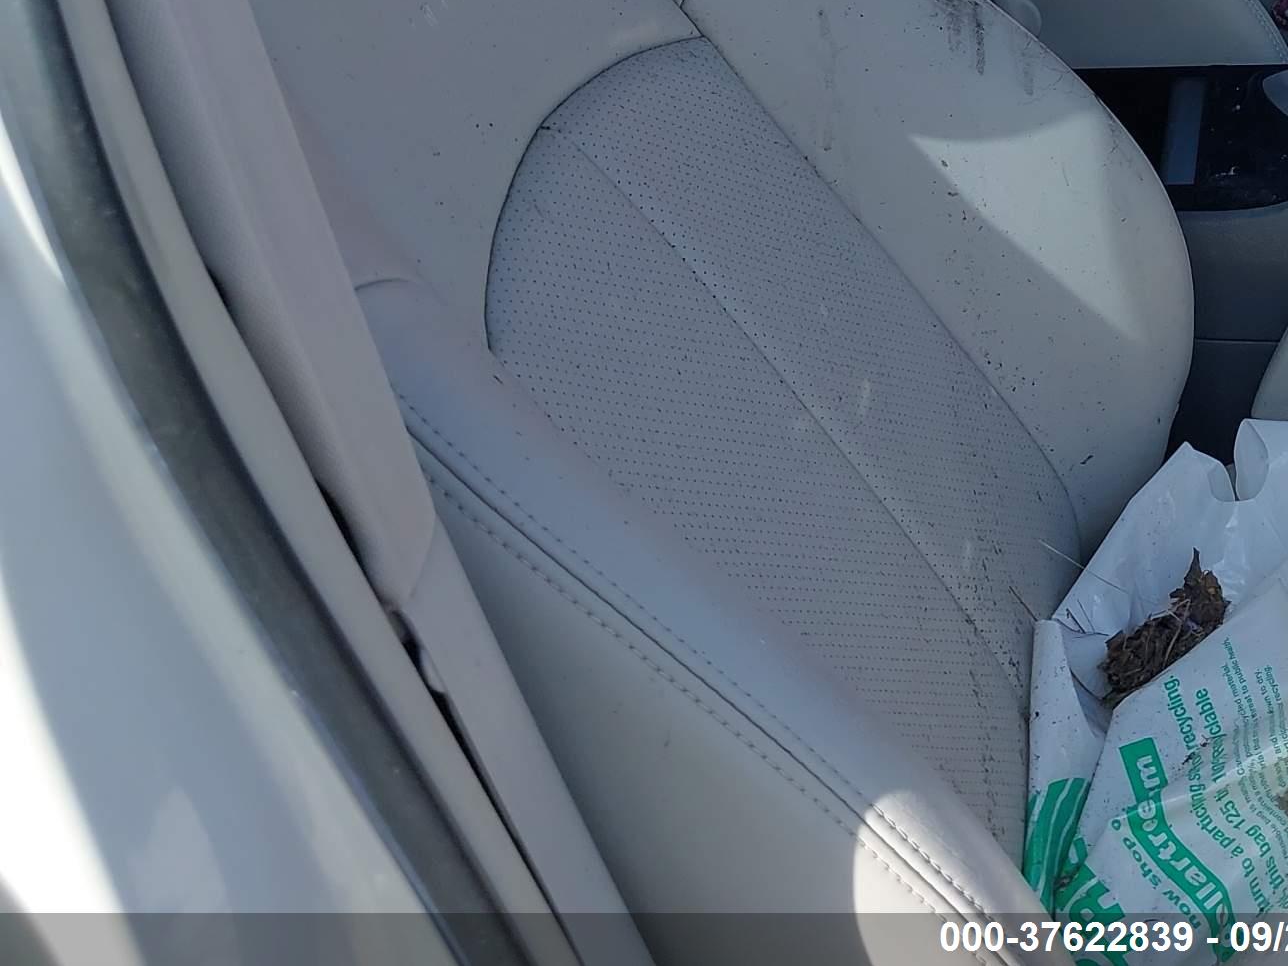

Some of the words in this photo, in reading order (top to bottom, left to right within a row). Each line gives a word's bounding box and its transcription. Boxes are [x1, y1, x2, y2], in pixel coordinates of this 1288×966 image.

[1163, 675, 1198, 752] recycling.
[1220, 800, 1246, 830] 125
[1245, 825, 1272, 858] bag
[1123, 837, 1162, 888] shop
[1242, 857, 1256, 878] to
[1266, 856, 1285, 890] this
